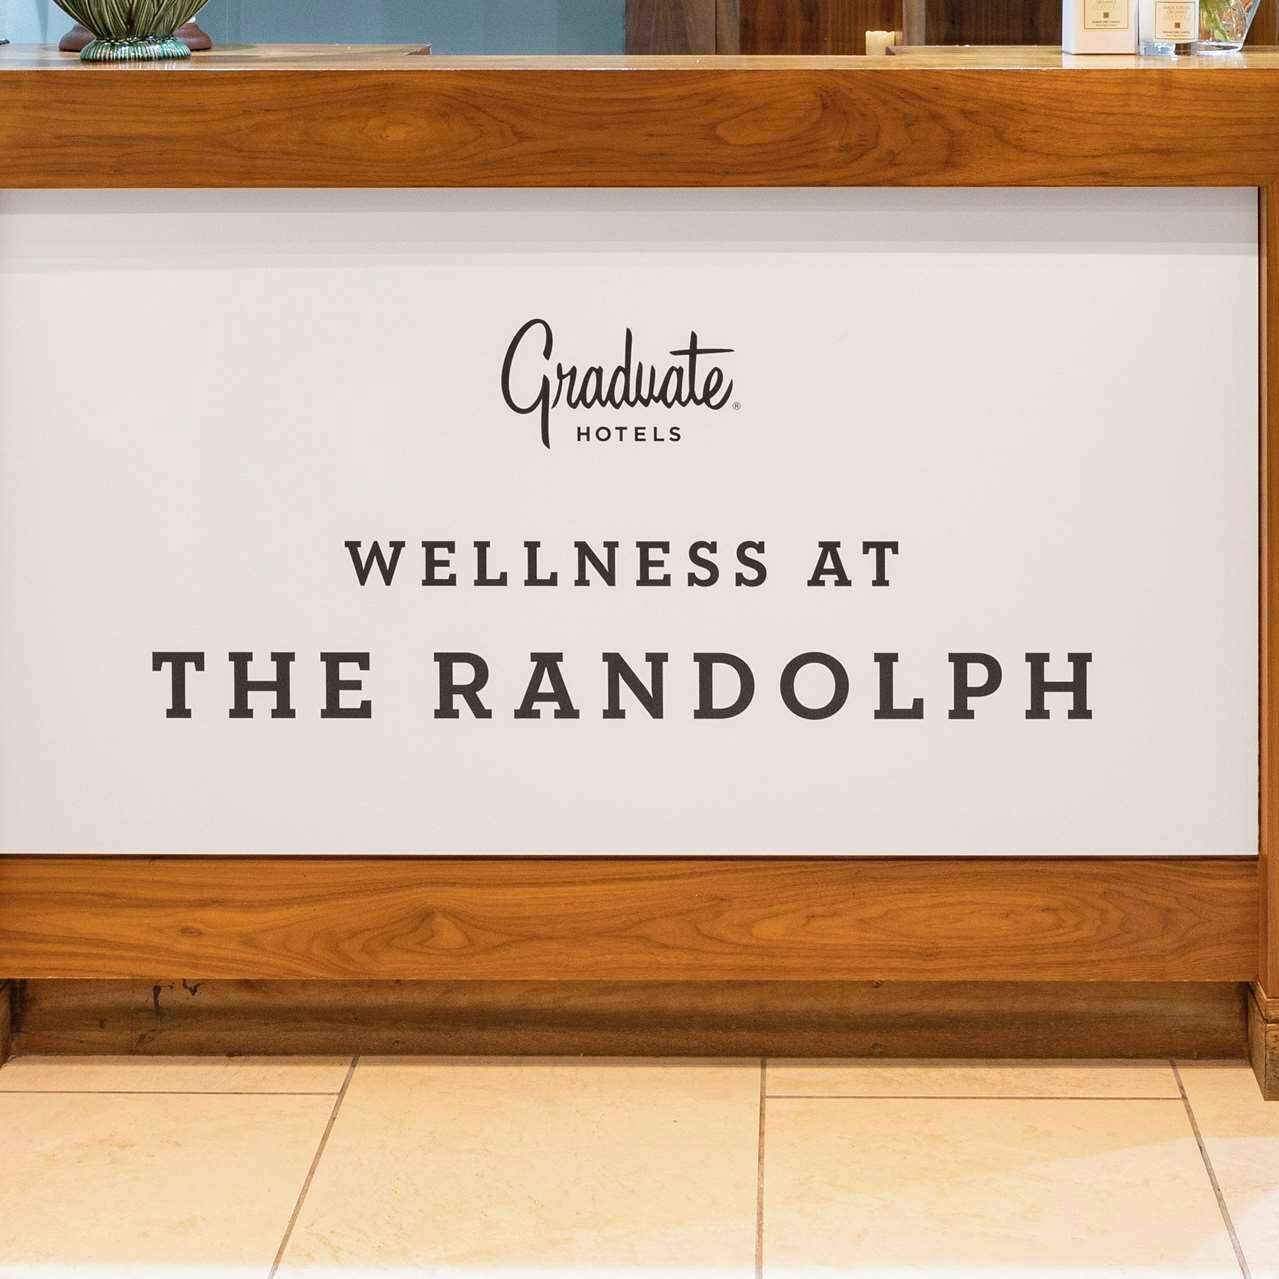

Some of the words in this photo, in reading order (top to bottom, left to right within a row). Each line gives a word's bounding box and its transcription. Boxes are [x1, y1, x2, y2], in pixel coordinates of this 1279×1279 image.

[500, 317, 735, 450] Graduate
[575, 425, 683, 443] HOTELS
[344, 540, 768, 588] WELLNESS
[806, 540, 900, 588] AT
[151, 651, 373, 721] THE
[433, 651, 1094, 721] RANDOLPH
